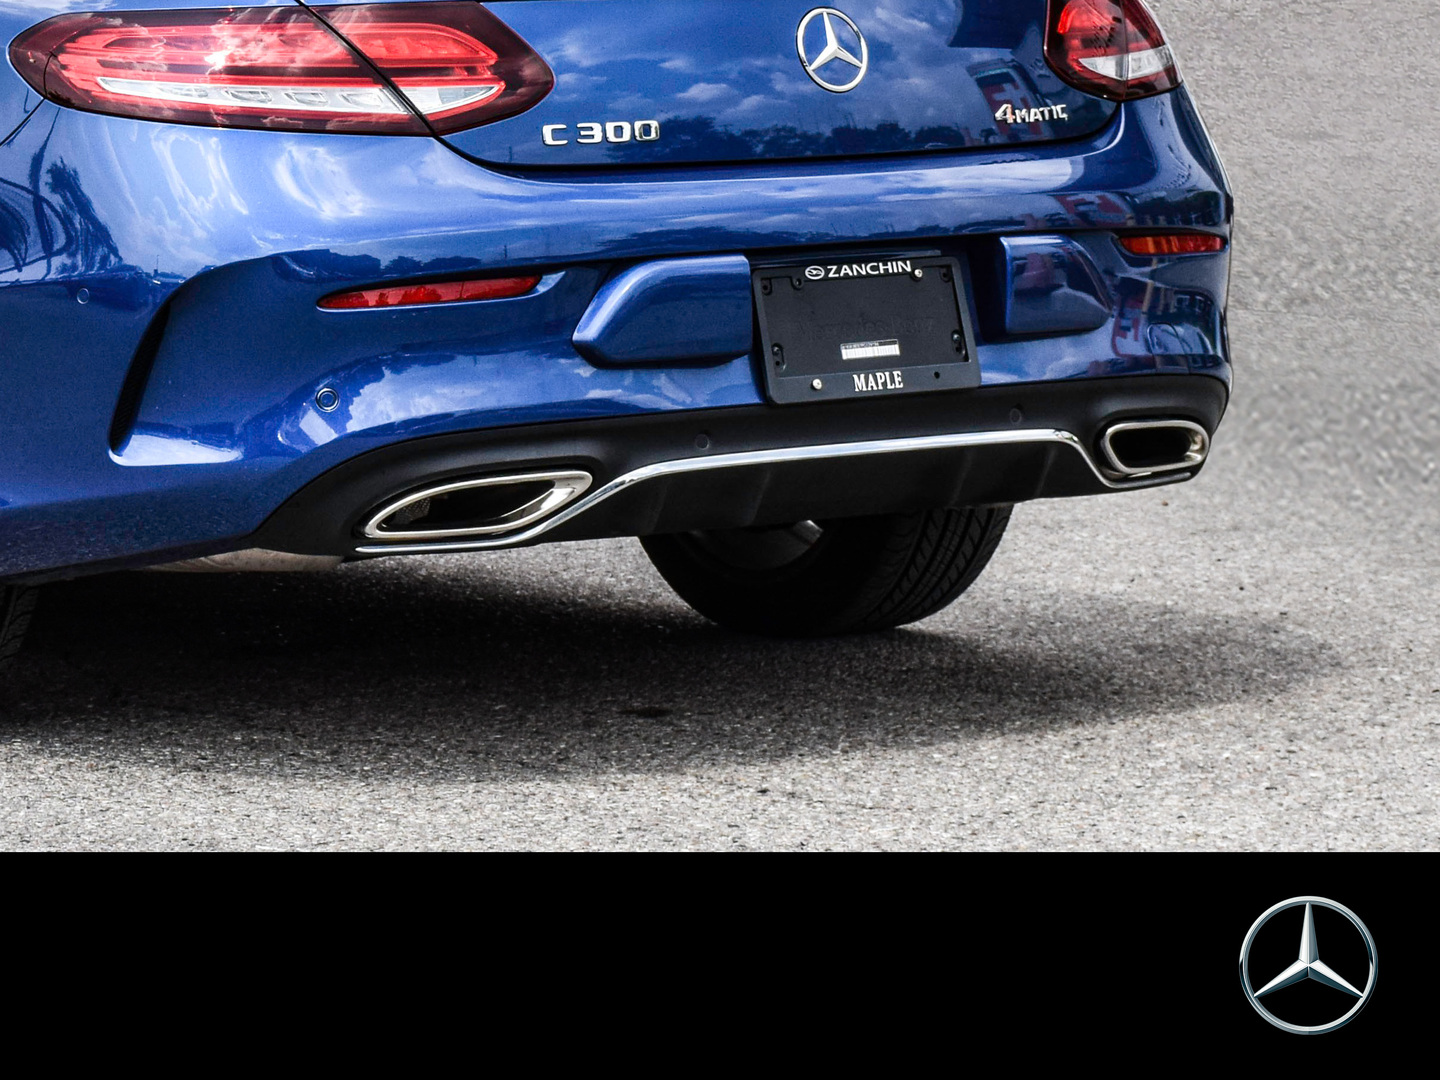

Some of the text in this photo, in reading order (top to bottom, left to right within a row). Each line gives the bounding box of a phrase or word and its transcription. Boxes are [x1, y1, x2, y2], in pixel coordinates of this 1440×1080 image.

[994, 103, 1068, 124] 4MATIC
[542, 120, 660, 146] C 300
[827, 260, 912, 278] ZANCHIN
[852, 370, 904, 392] MAPLE
